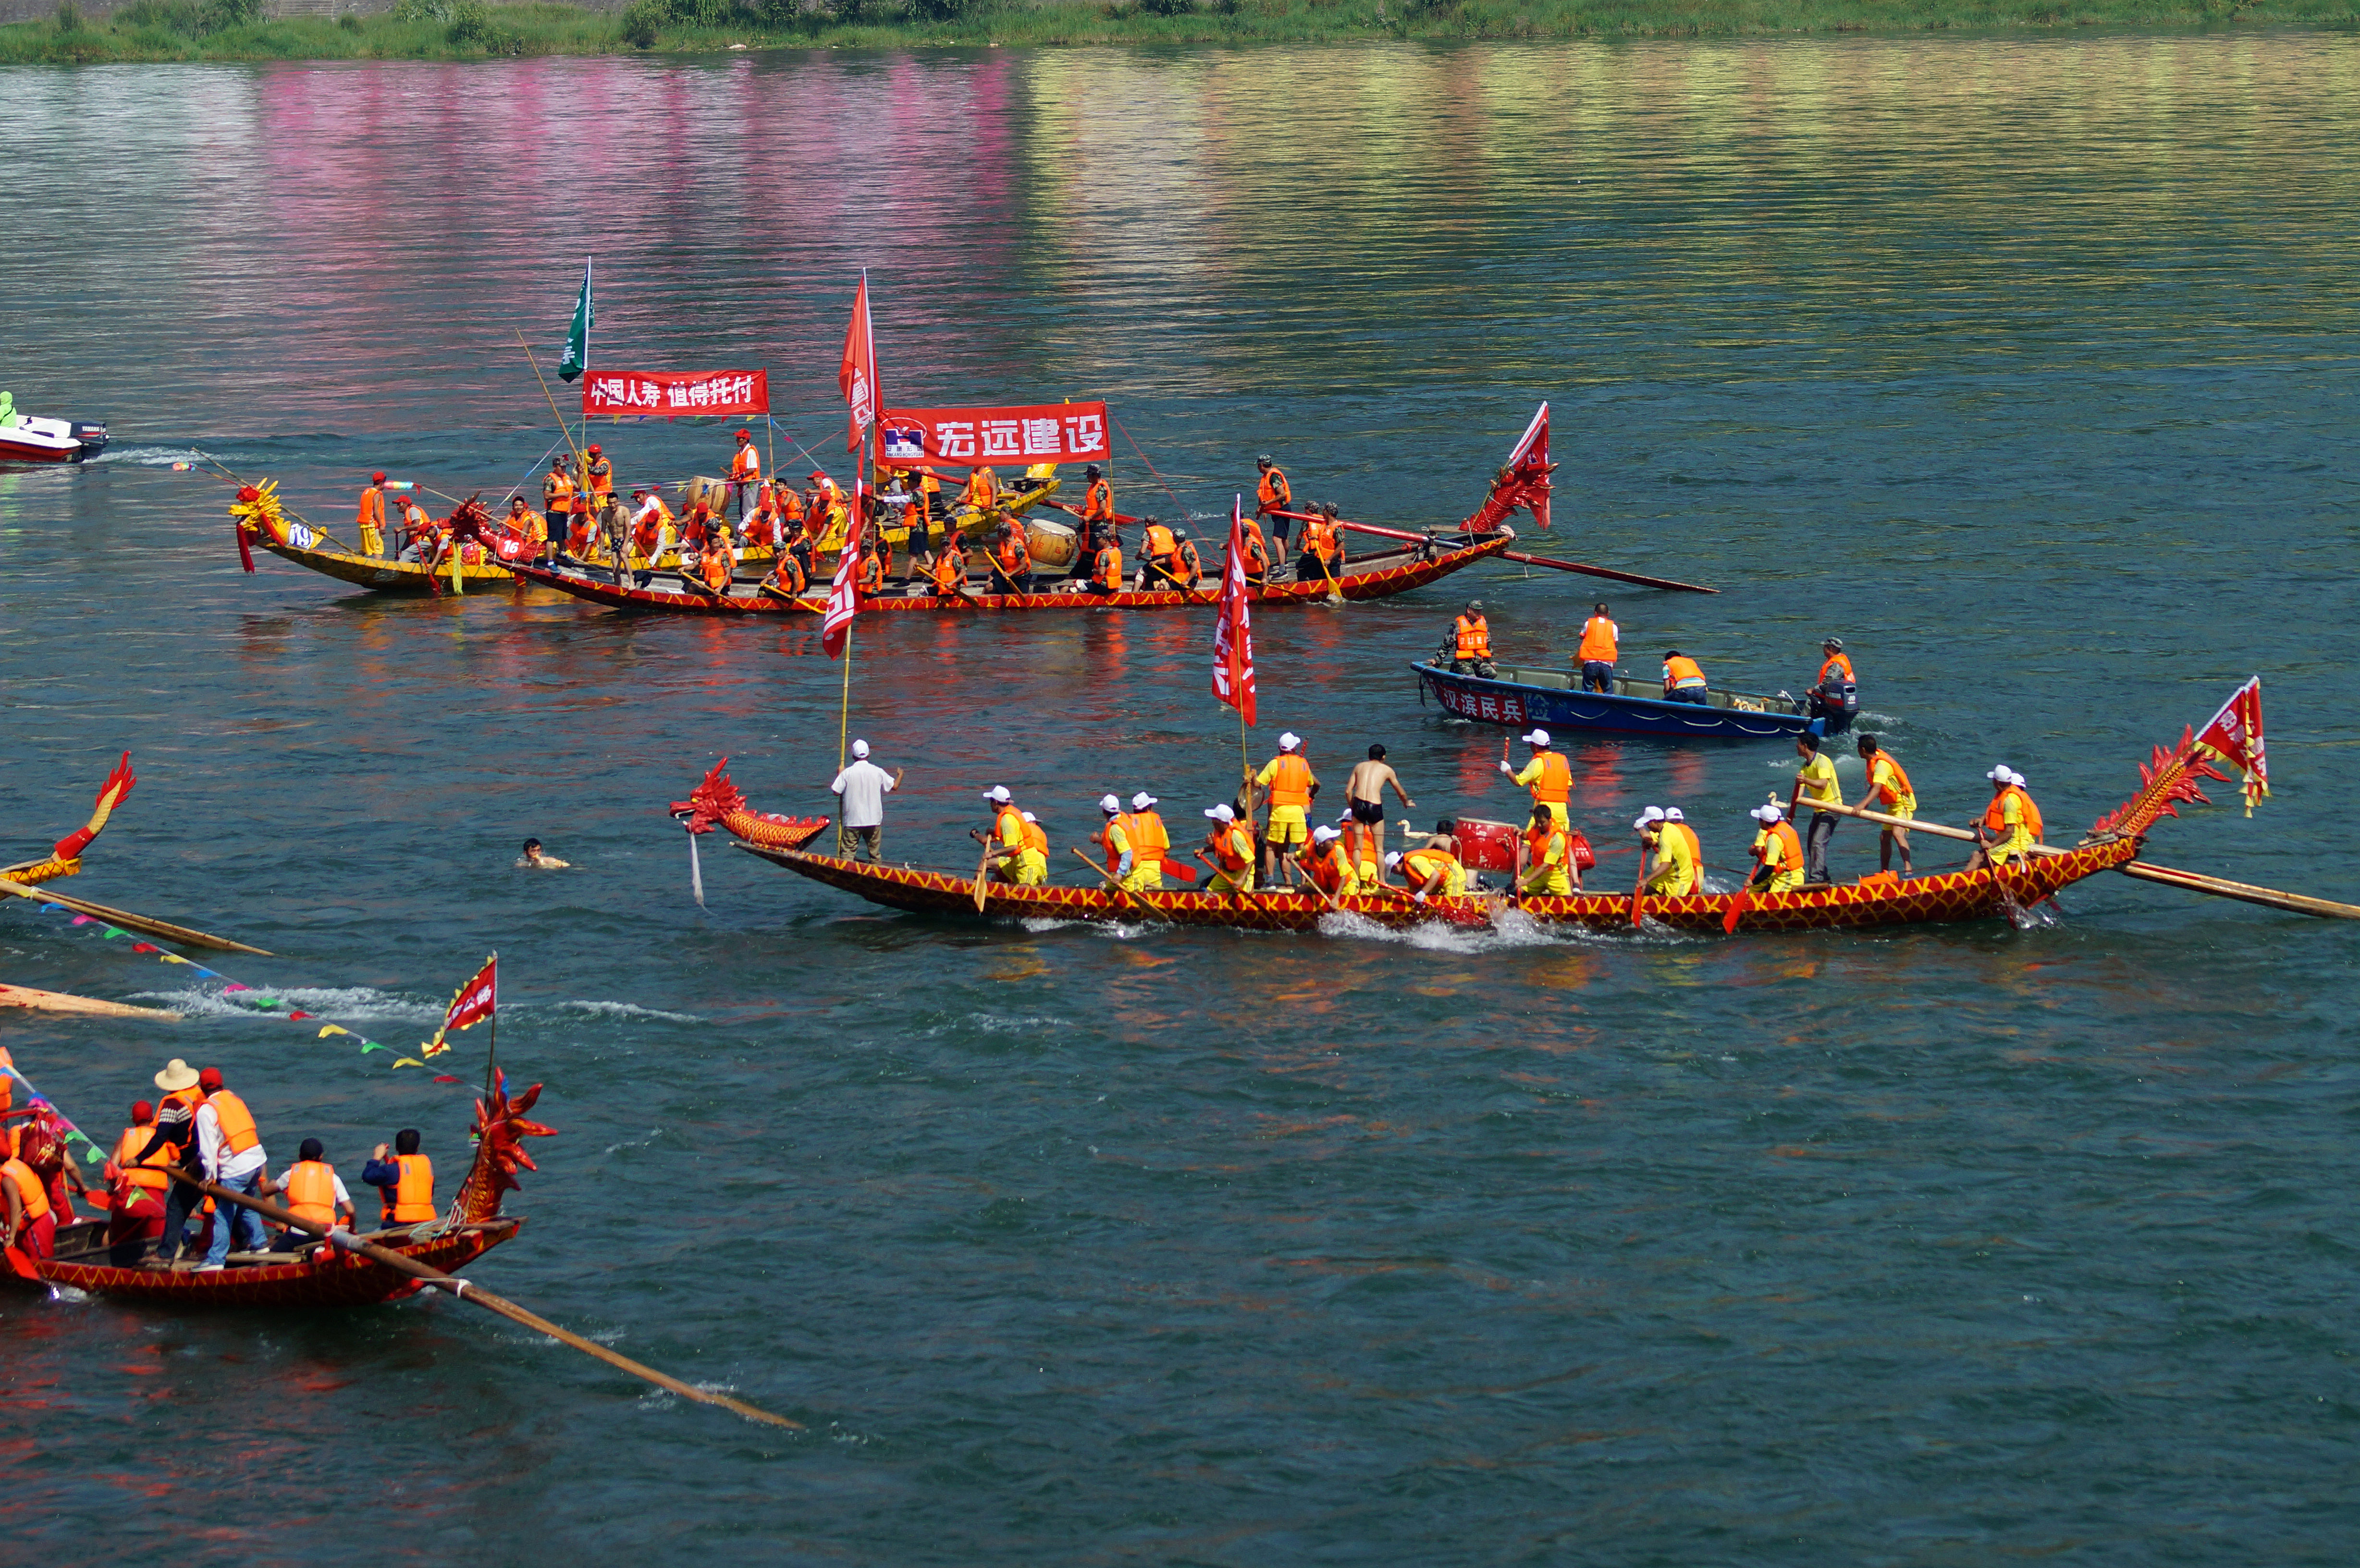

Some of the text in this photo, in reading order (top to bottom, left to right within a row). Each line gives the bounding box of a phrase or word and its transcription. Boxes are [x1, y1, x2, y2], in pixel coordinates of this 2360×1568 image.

[590, 375, 754, 407] 中国人寿 值得托付
[936, 414, 1104, 457] 宏远建设
[290, 523, 311, 546] 19
[504, 540, 519, 553] 16
[1443, 687, 1522, 723] 汉滨民兵
